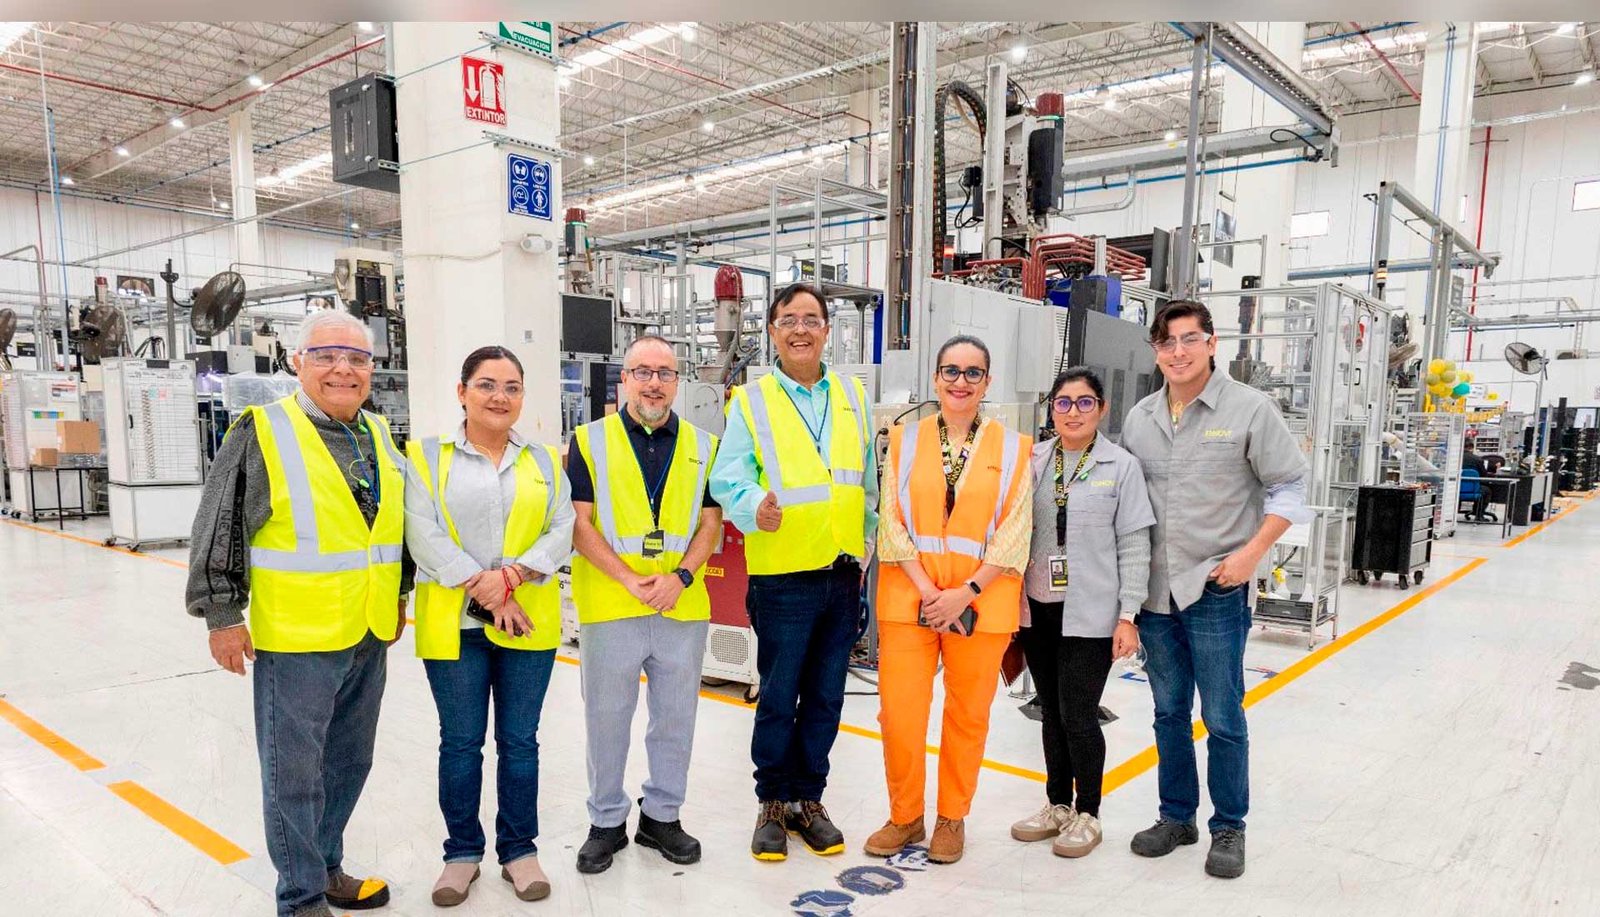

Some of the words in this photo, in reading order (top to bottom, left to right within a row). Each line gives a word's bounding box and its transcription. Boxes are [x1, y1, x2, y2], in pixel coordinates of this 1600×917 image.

[512, 31, 550, 51] EVACUACION
[467, 108, 506, 125] EXTINTOR
[217, 509, 232, 548] NEW
